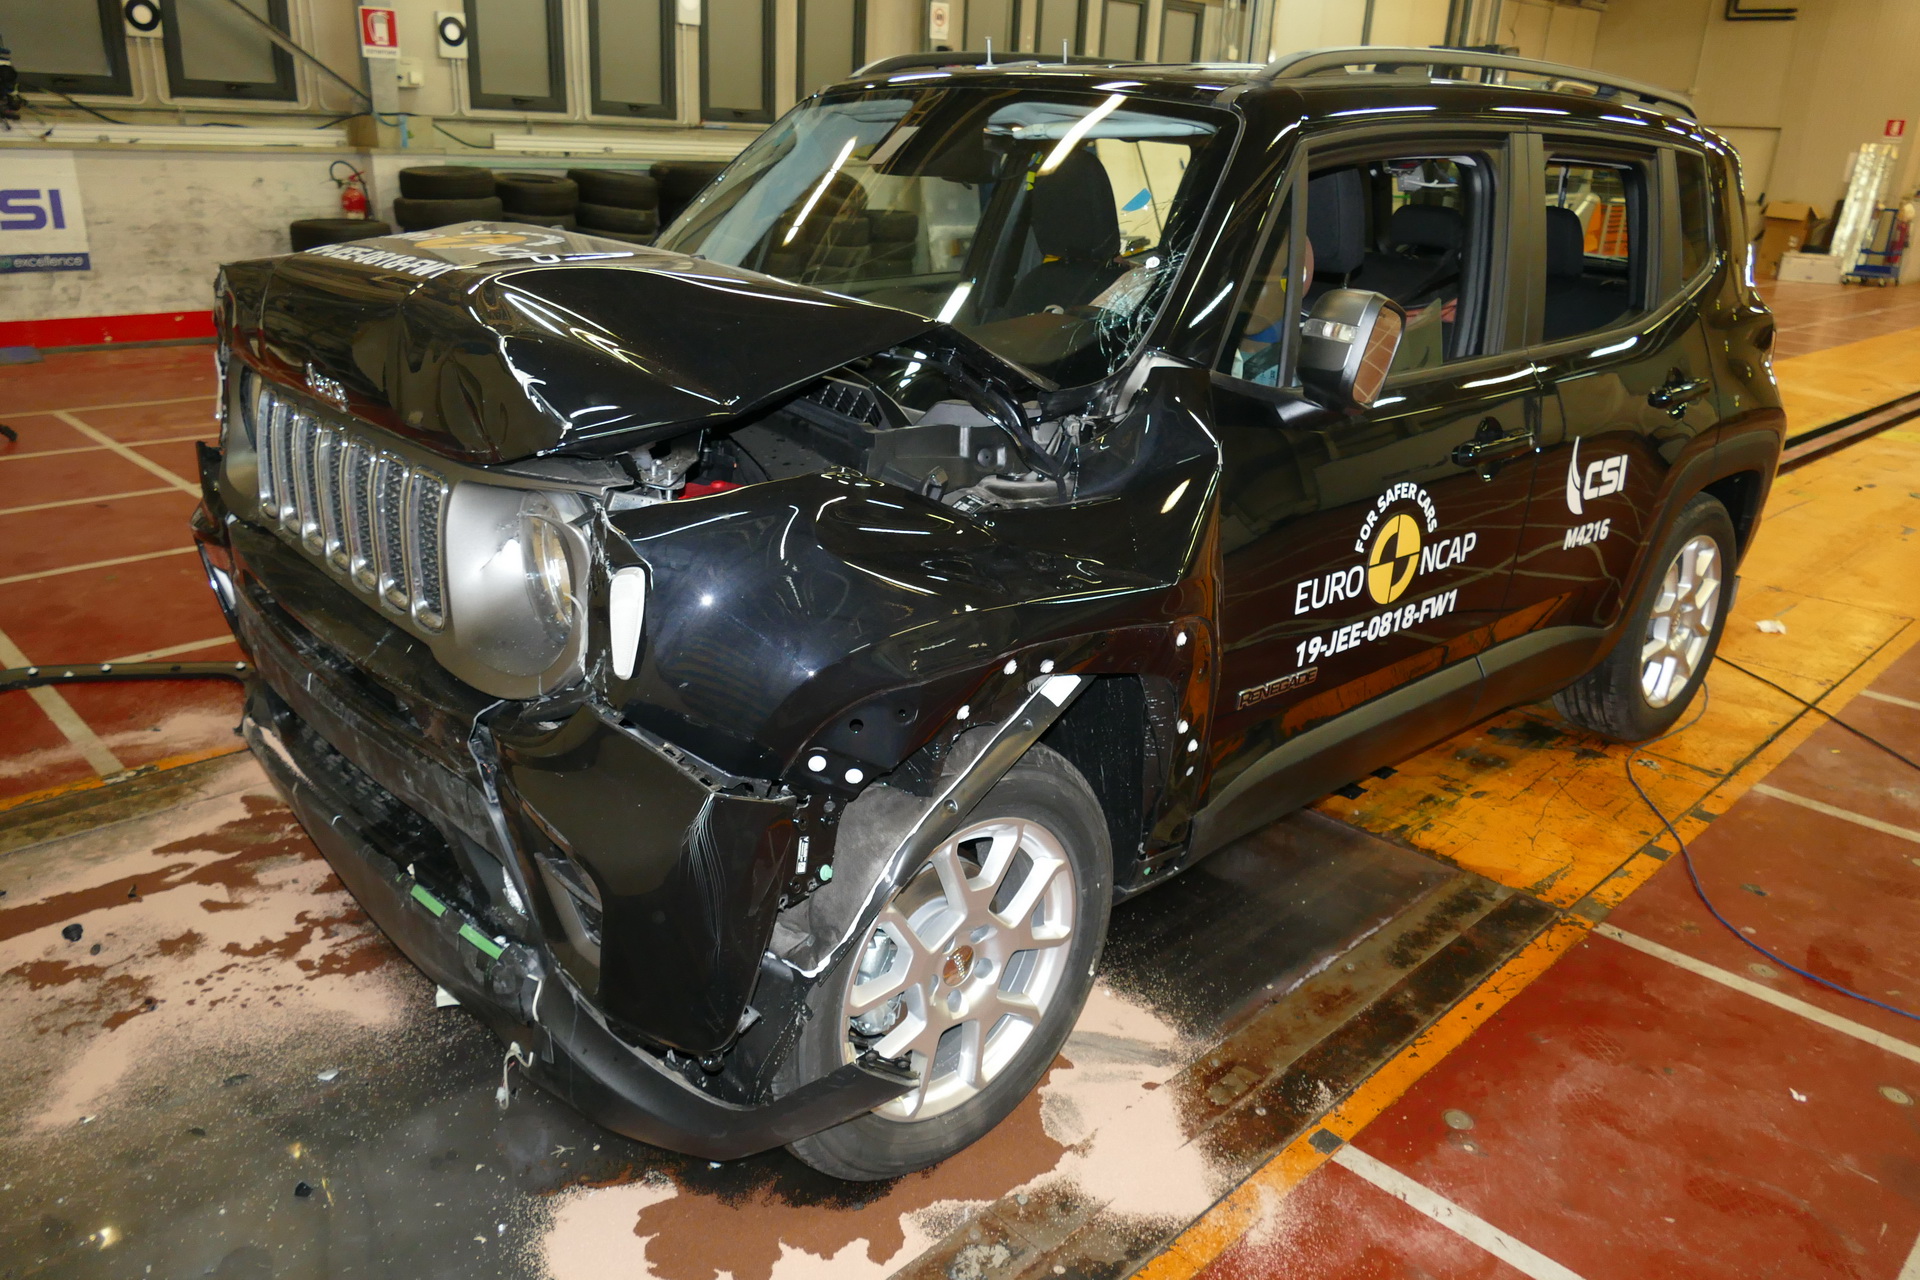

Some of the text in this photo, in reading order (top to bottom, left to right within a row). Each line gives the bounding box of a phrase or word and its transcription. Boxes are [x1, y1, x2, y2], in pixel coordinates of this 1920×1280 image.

[13, 255, 84, 268] excellence
[1583, 454, 1628, 501] CSI
[1354, 482, 1438, 554] FOR SAFER CARS
[1563, 518, 1611, 551] M4216
[1294, 532, 1477, 616] EURO NCAP
[1296, 588, 1458, 668] 19-JEE-0818-FW1
[1237, 667, 1318, 710] RENEGADE
